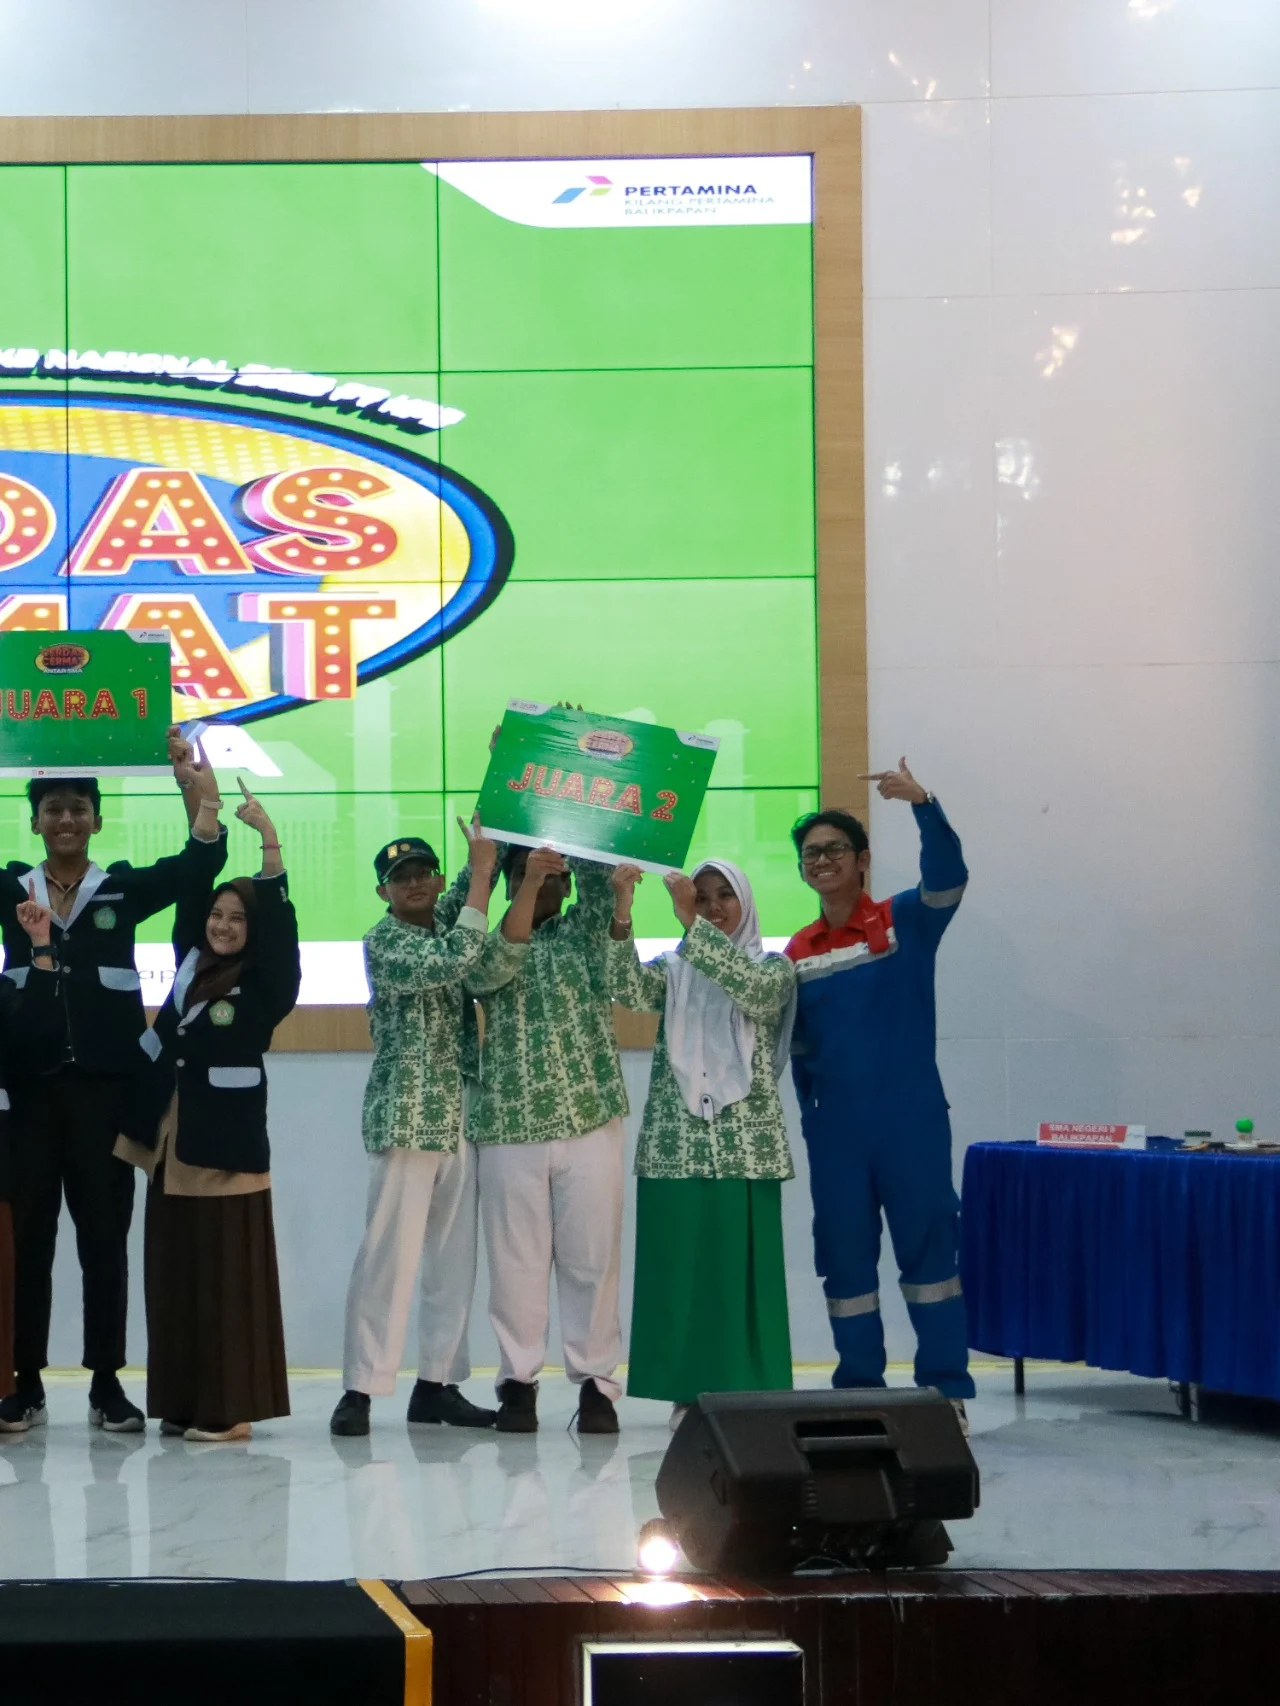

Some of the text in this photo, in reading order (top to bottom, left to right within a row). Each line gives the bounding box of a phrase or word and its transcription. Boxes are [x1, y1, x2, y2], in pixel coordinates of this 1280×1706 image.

[625, 184, 758, 197] PERTAMINA
[625, 196, 776, 206] KILANG PERTAMINA
[625, 207, 717, 216] BALIKPAPAN
[130, 688, 148, 719] 1
[507, 763, 678, 822] JUARA 2
[1051, 1132, 1113, 1143] BALIKPAPAN
